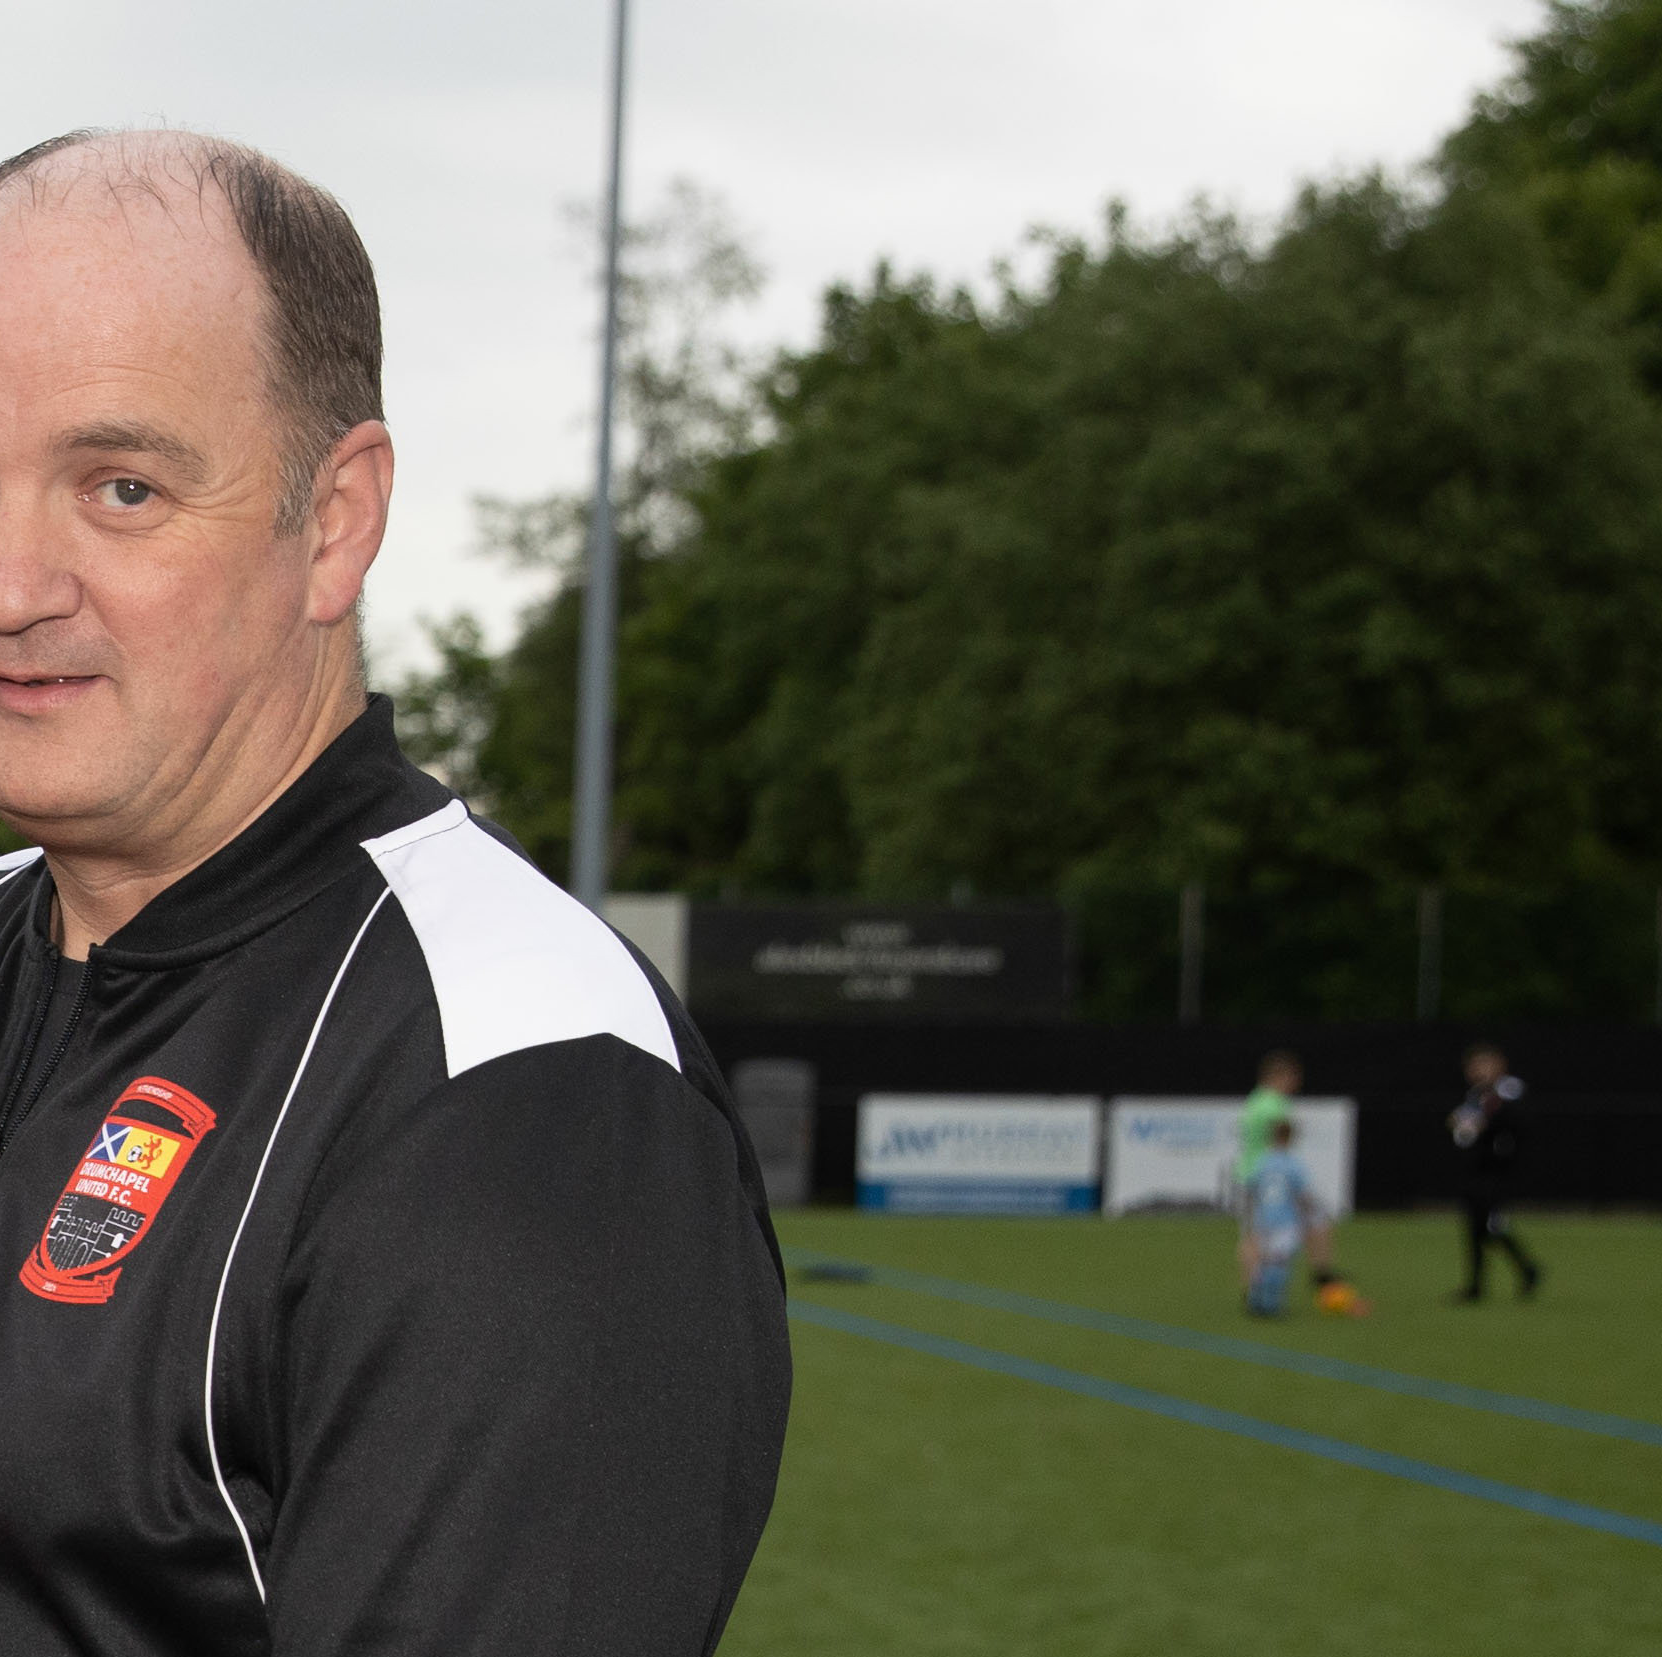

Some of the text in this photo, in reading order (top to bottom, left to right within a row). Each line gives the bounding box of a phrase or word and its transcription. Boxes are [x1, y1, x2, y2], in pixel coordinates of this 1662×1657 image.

[79, 1161, 150, 1193] DRUMCHAPEL
[75, 1178, 132, 1207] UNITED F.C.
